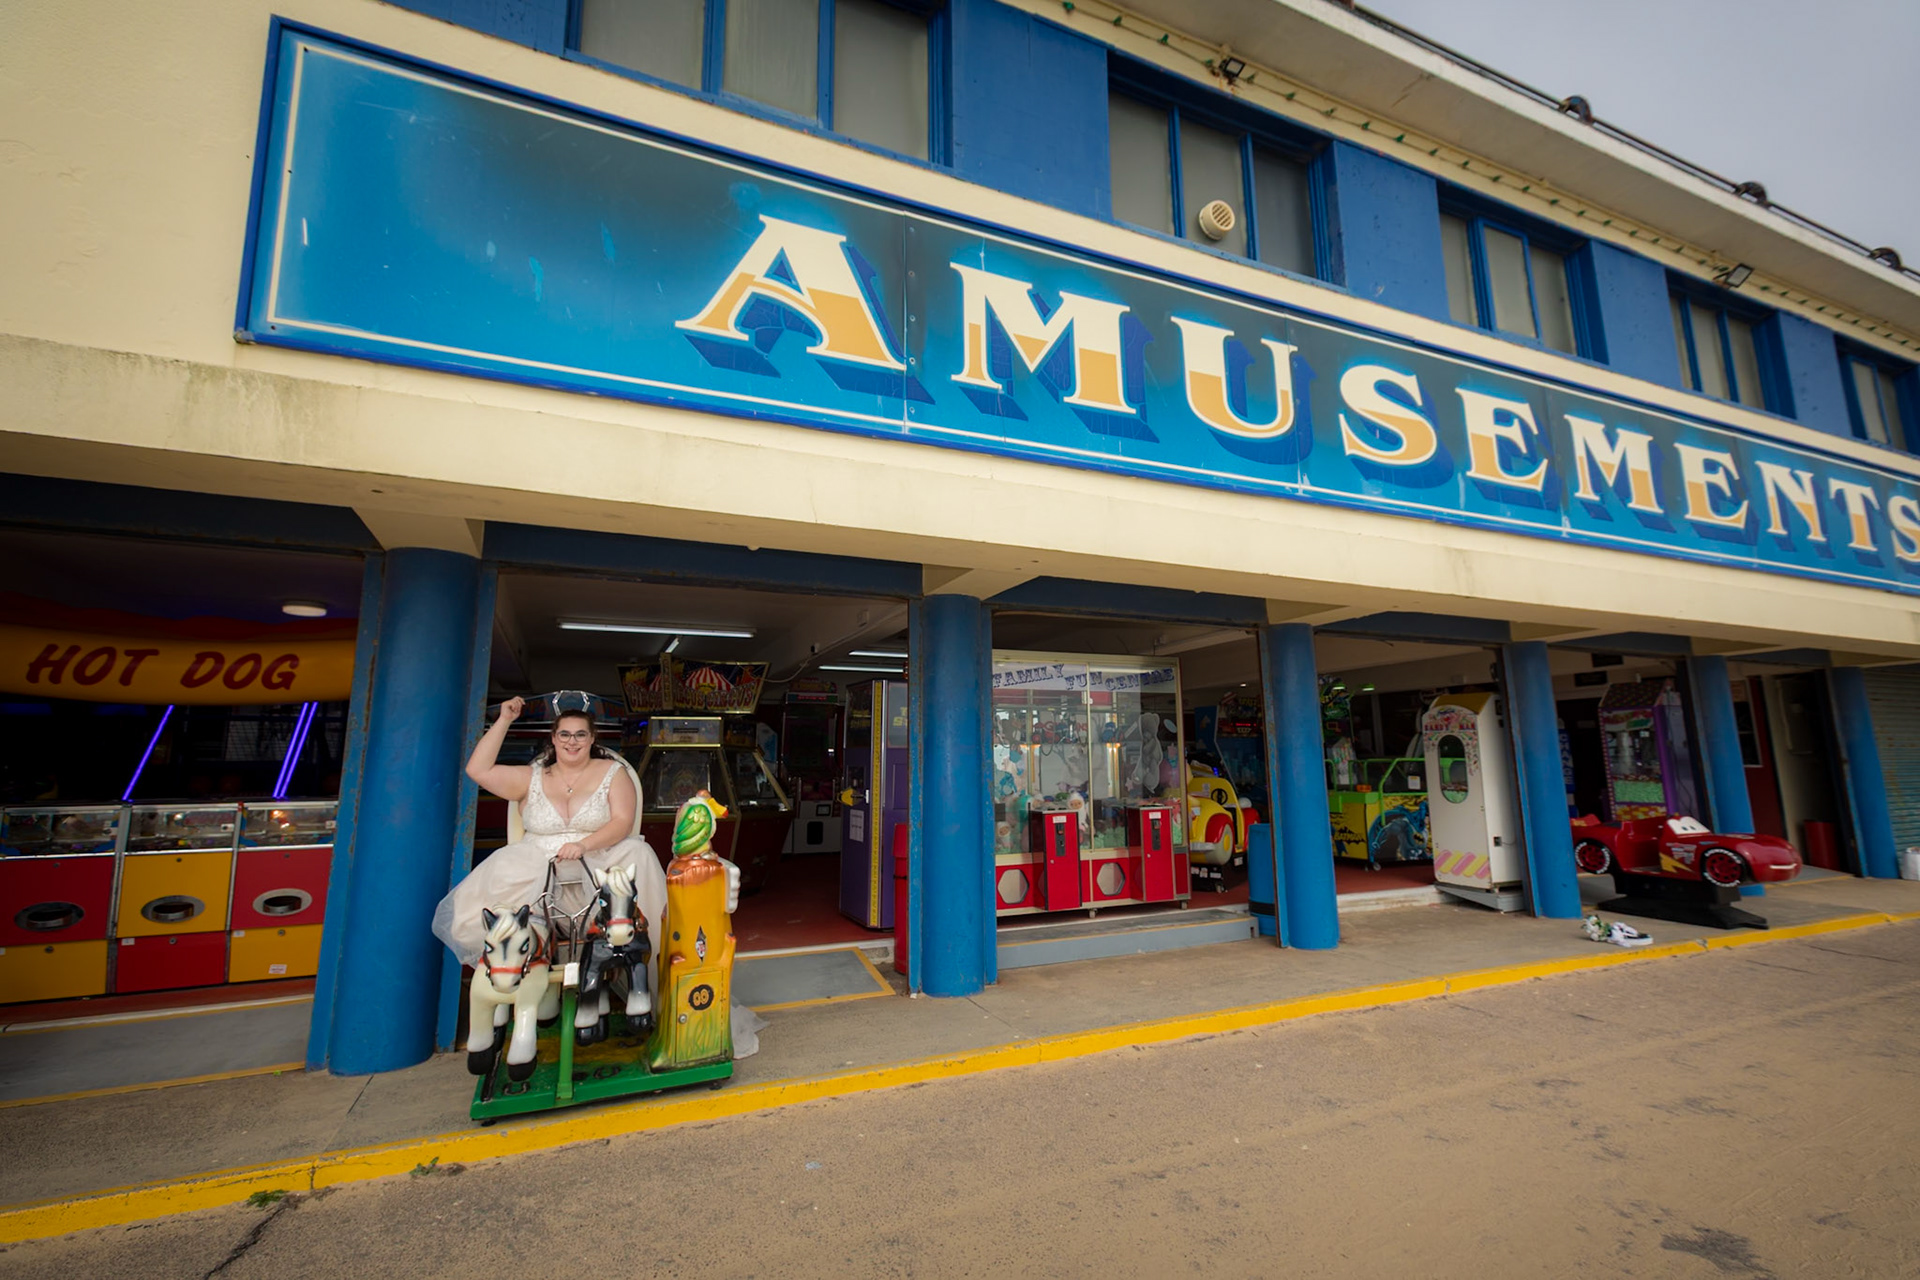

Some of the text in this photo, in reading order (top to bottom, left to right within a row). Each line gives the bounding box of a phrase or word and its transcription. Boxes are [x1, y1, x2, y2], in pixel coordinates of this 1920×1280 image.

[675, 214, 1920, 562] AMUSEMENTS
[26, 644, 299, 690] HOT DOG
[992, 664, 1175, 691] FAMILY FUN CENTRE
